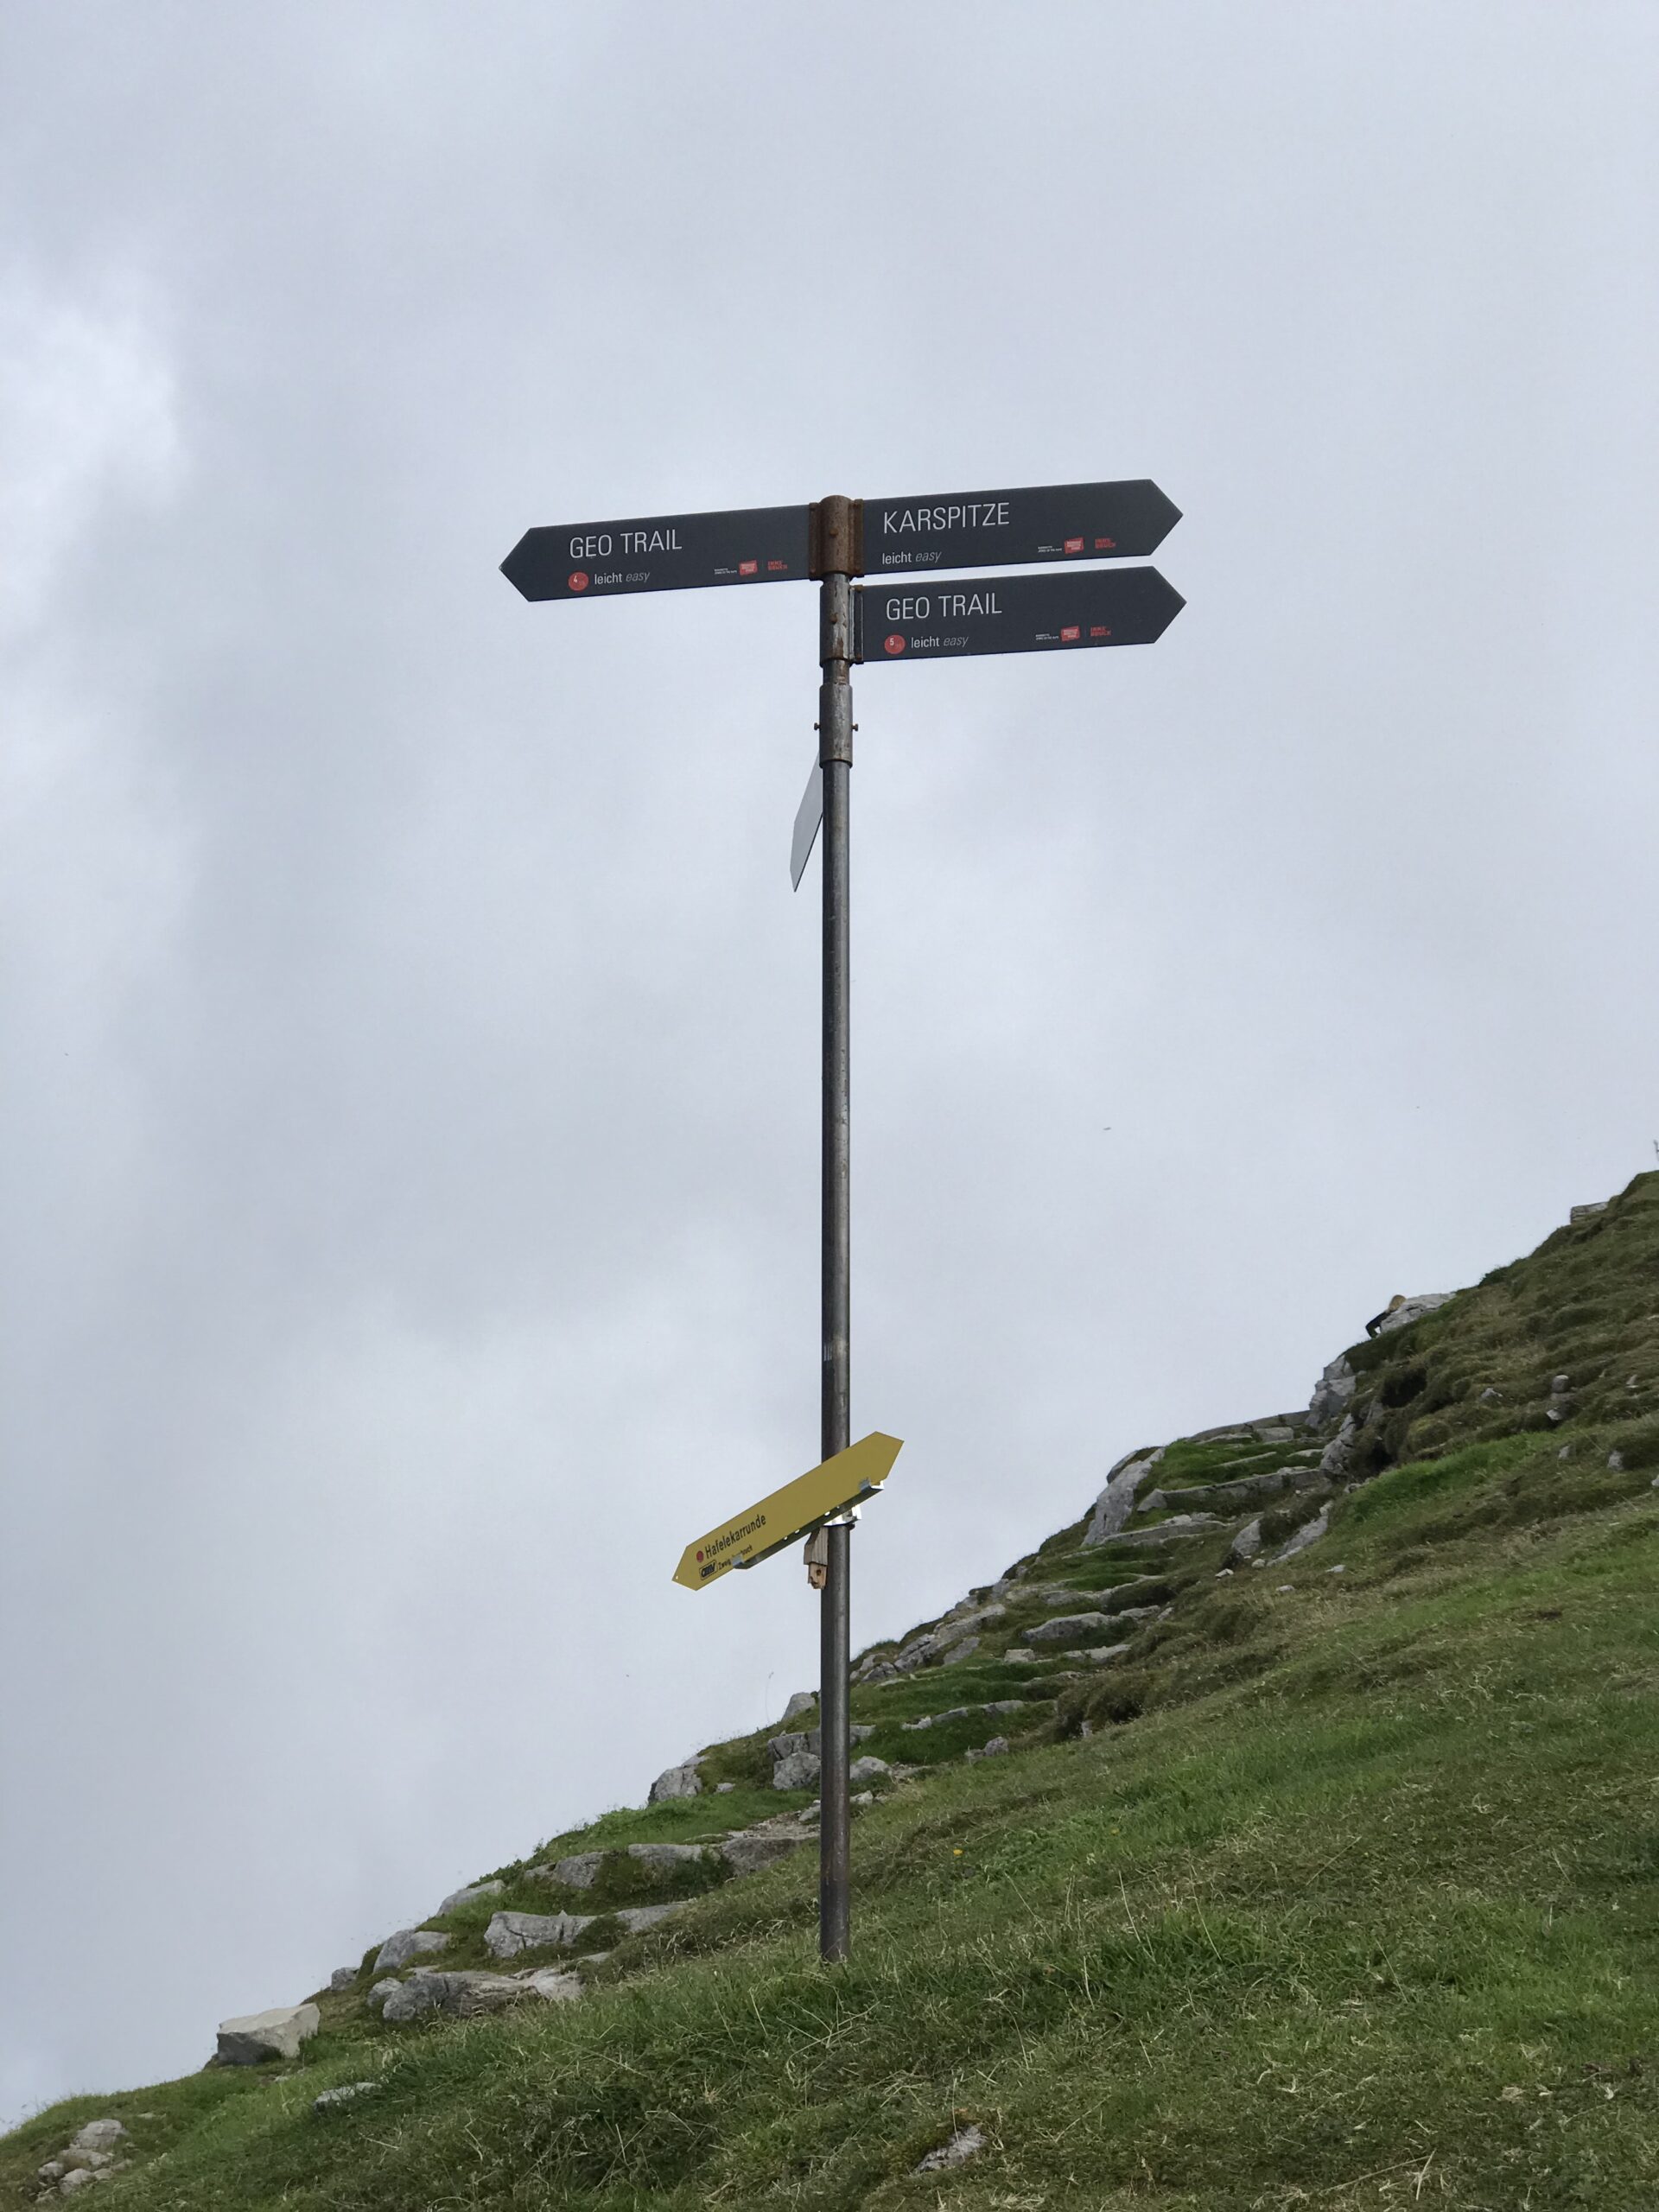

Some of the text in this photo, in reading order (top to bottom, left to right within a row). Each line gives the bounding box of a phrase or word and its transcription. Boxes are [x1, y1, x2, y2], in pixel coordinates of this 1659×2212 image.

[883, 502, 1010, 534] KARSPITZE
[569, 529, 683, 559] GEO TRAIL
[881, 550, 942, 565] leicht easy
[573, 570, 651, 586] 4 leicht easy
[886, 592, 1002, 621] GEO TRAIL
[888, 634, 969, 649] 5 leicht easy
[704, 1514, 766, 1560] Hafelekarrunde
